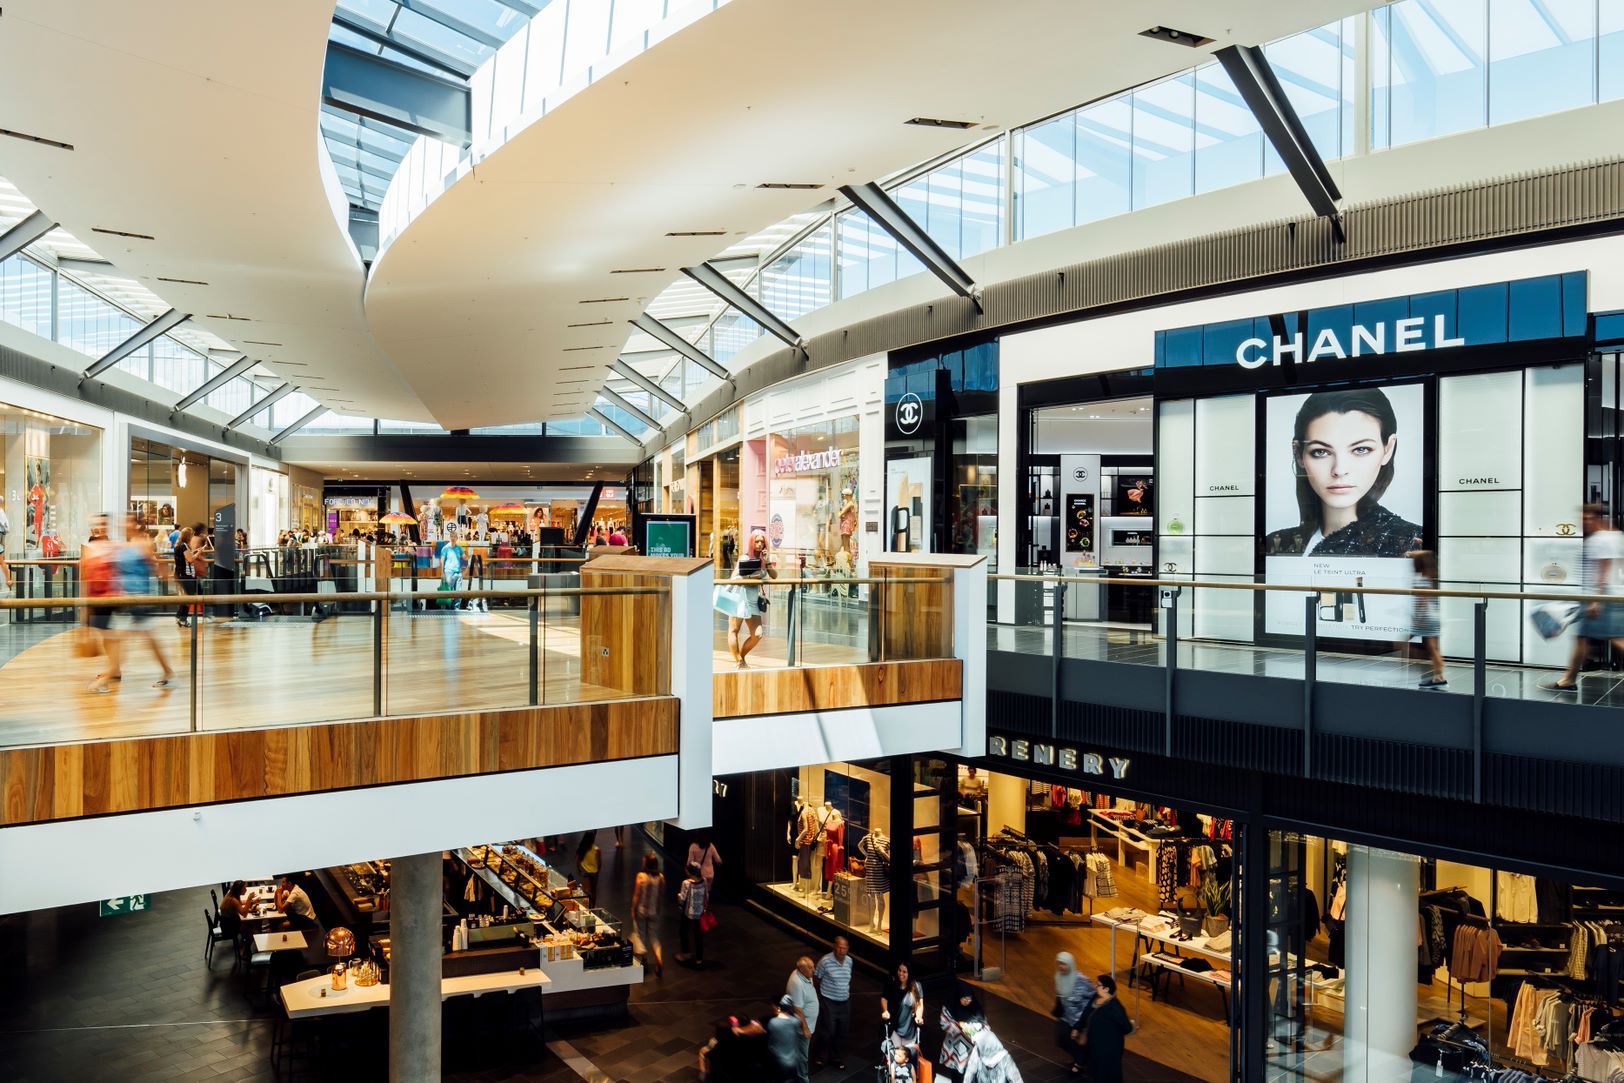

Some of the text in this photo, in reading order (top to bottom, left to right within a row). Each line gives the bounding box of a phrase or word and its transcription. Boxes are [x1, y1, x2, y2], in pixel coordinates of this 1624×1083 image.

[1236, 314, 1465, 369] CHANEL
[1459, 477, 1500, 485] CHANEL
[215, 512, 222, 522] 3
